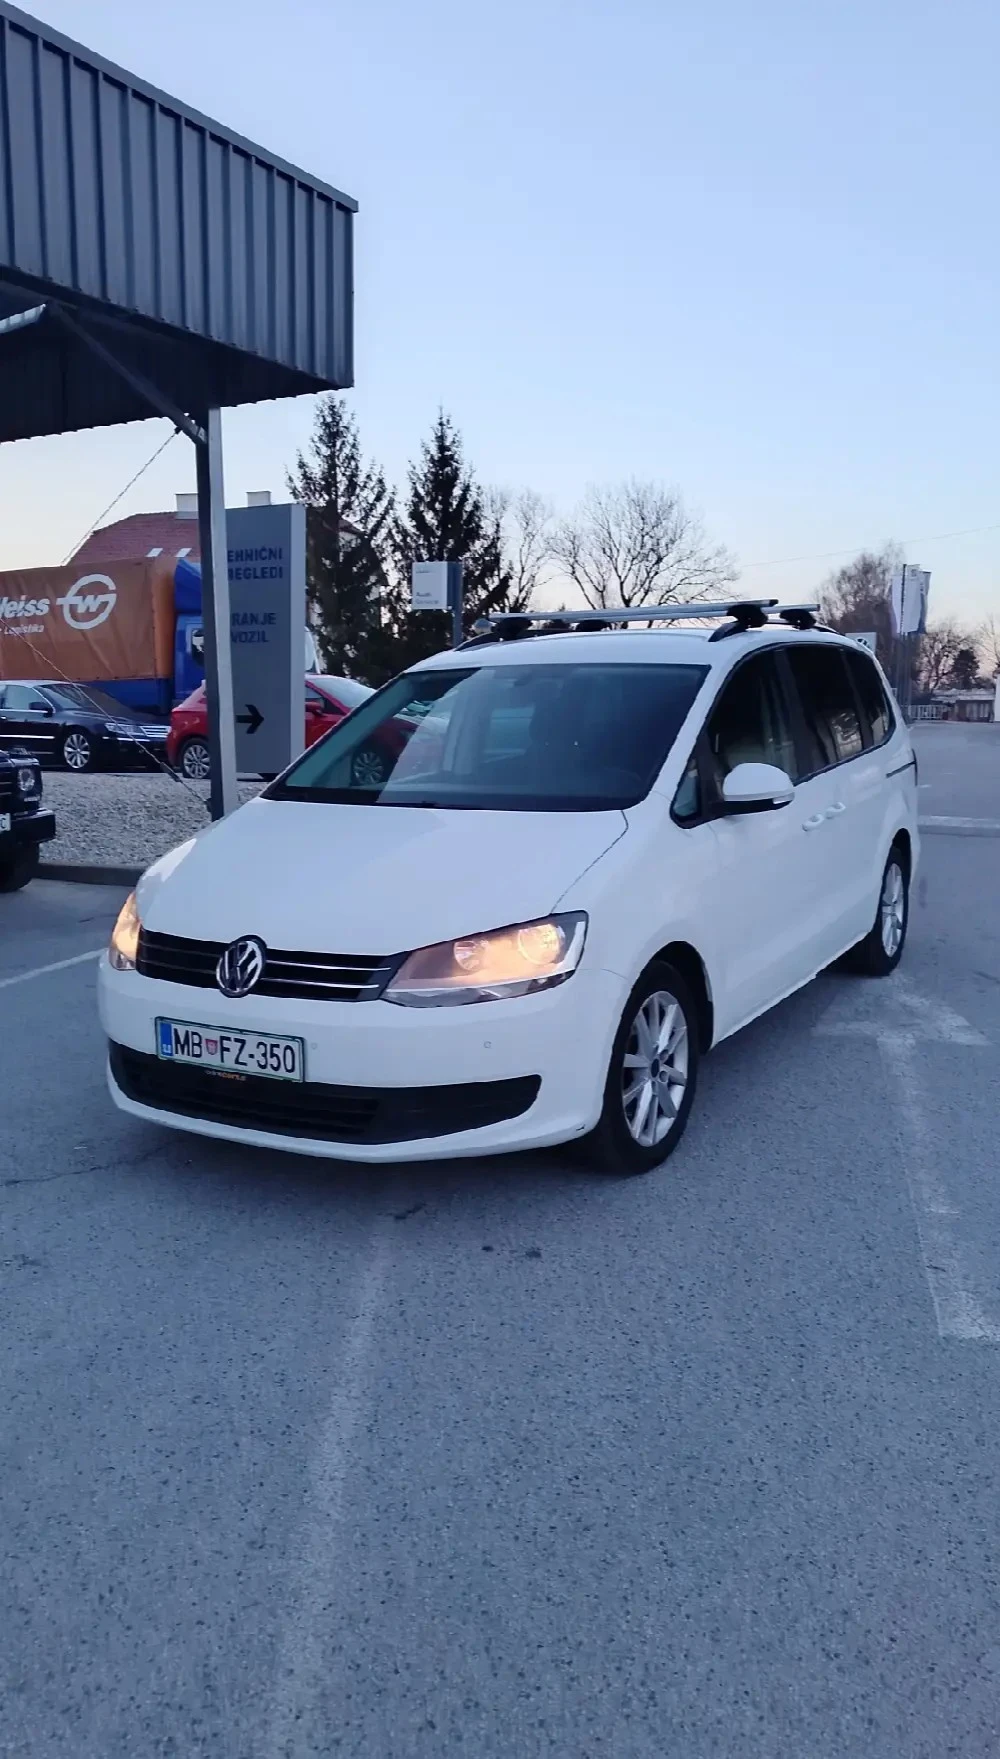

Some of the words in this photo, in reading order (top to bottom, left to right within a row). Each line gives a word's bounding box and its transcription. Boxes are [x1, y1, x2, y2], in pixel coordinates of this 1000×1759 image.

[227, 546, 282, 562] EHNIČNI
[231, 612, 277, 626] RANJE
[173, 1027, 203, 1058] MB
[219, 1035, 296, 1073] FZ-350
